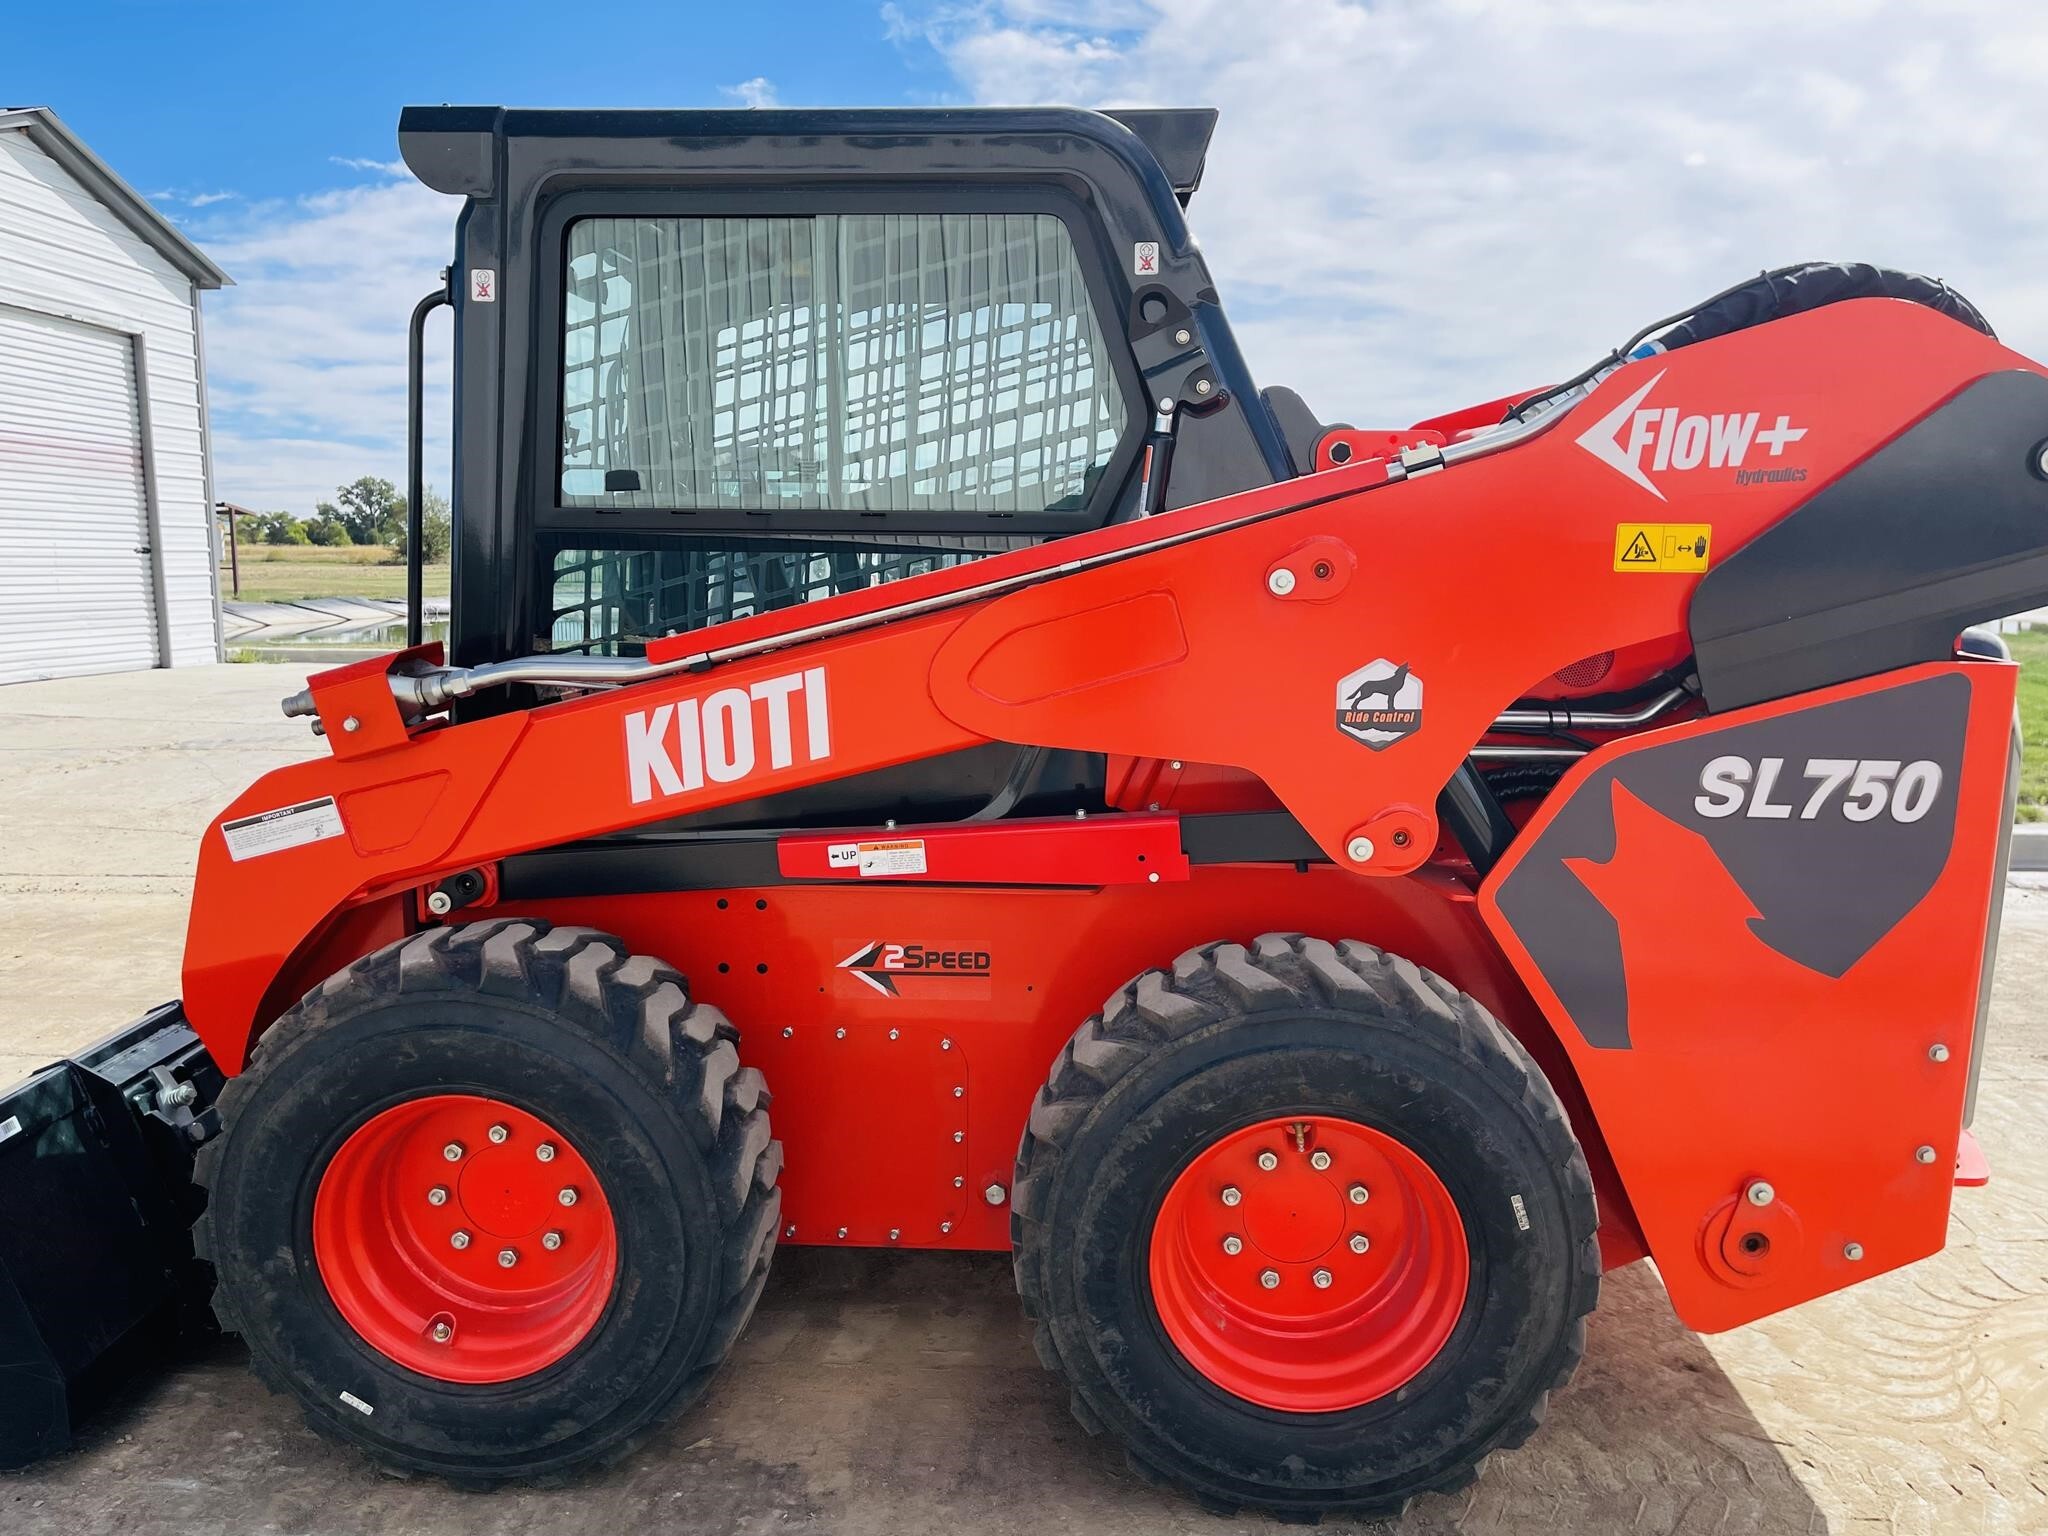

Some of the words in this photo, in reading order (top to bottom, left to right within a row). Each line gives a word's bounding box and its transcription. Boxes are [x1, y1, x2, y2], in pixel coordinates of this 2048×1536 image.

[1736, 467, 1807, 486] Hydraulics
[1345, 711, 1370, 723] Ride
[1373, 711, 1415, 723] Control
[625, 666, 830, 804] KIOTI
[261, 808, 294, 821] IMPORTANT
[841, 850, 857, 860] UP
